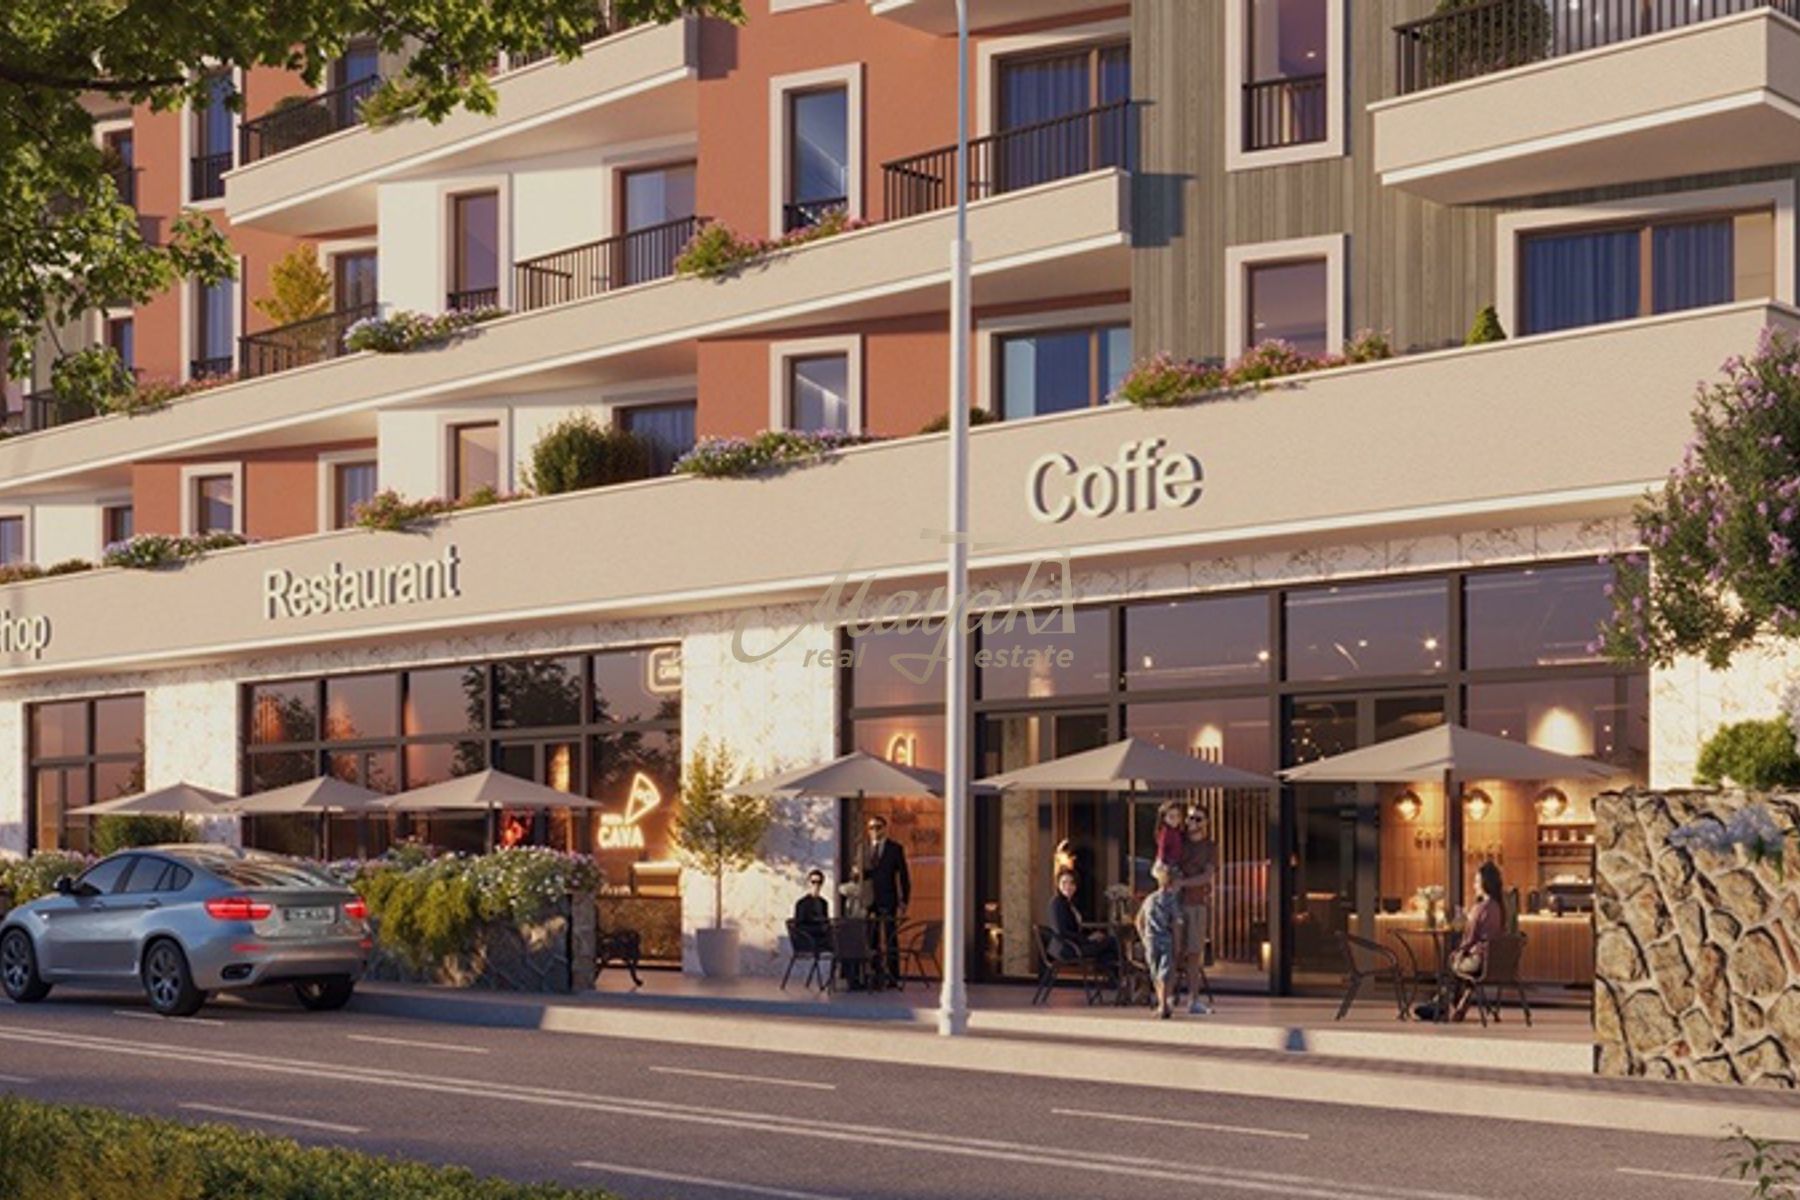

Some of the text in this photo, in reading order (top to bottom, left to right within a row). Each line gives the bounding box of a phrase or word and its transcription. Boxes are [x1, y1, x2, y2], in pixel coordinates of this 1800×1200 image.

[1027, 439, 1204, 523] Coffe
[264, 545, 461, 620] Restaurant
[0, 609, 53, 660] hop
